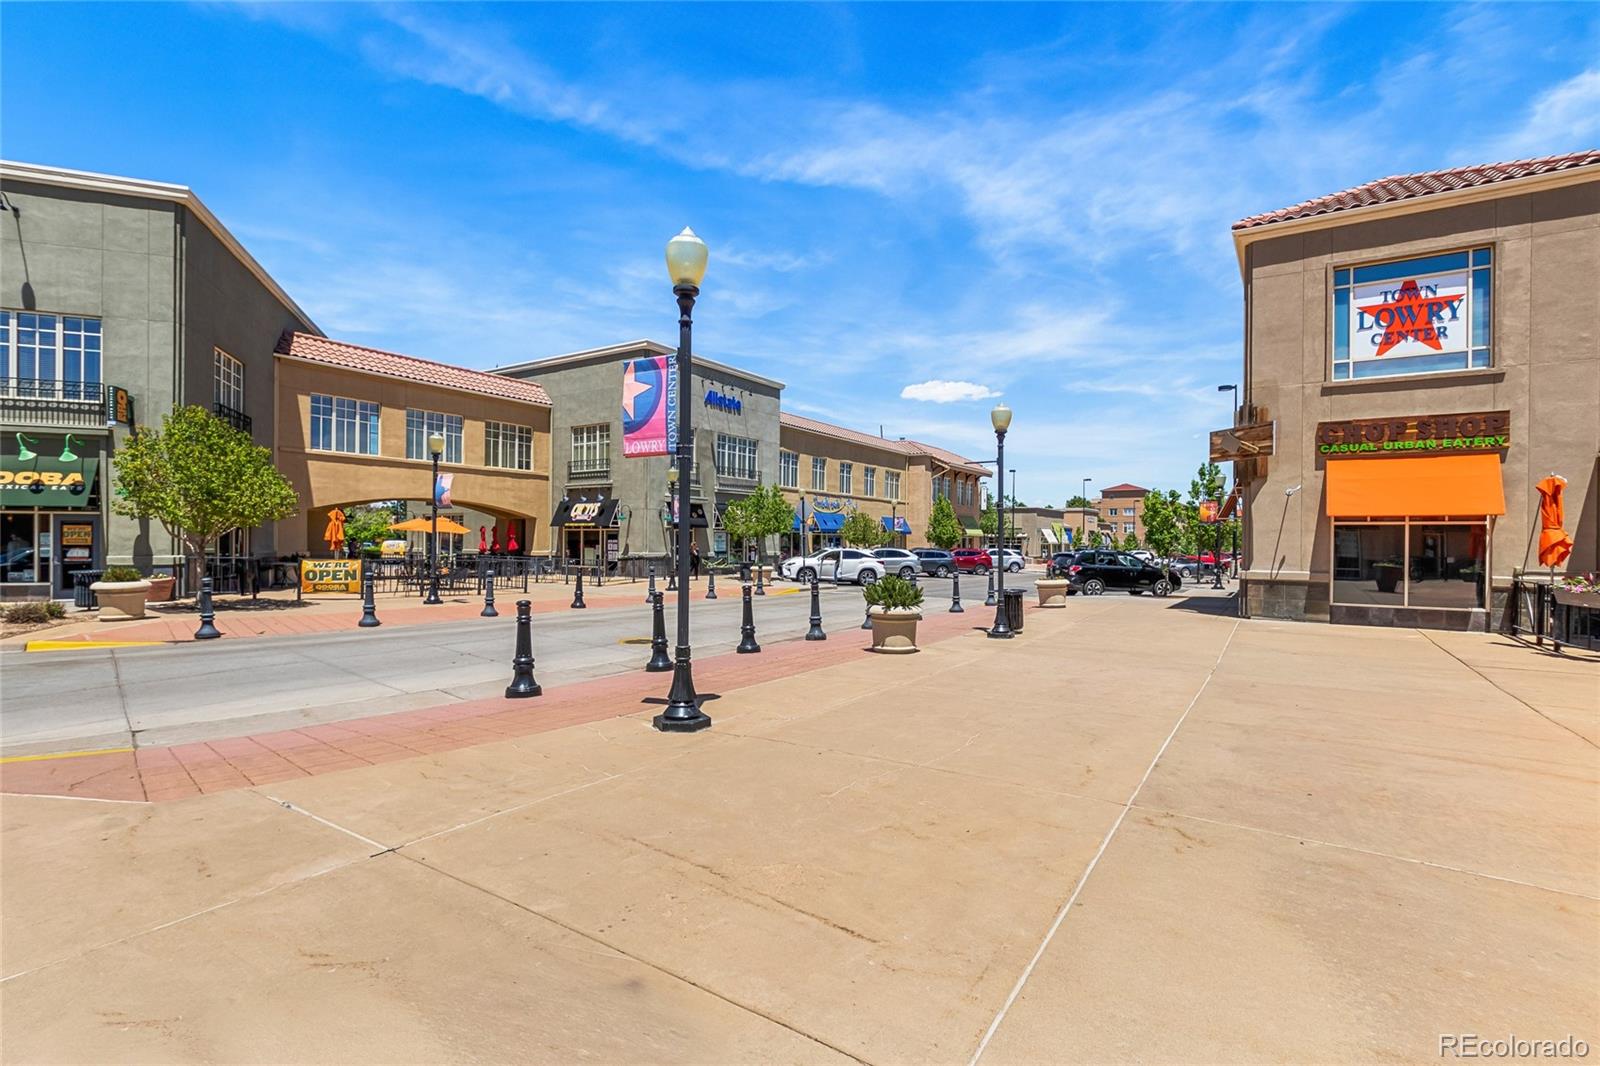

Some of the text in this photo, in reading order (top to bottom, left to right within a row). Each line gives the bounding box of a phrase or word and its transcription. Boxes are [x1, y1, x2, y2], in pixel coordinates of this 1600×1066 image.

[1379, 283, 1439, 303] TOWN
[1357, 298, 1464, 333] LOWRY
[1371, 325, 1449, 347] CENTER
[667, 354, 678, 451] TOWN CENTER
[704, 390, 743, 412] Allstate
[1321, 415, 1506, 444] CHOP SHOP
[624, 439, 667, 454] LOWRY
[1320, 435, 1506, 454] CASUAL URBAN EATERY
[304, 569, 357, 581] OPEN
